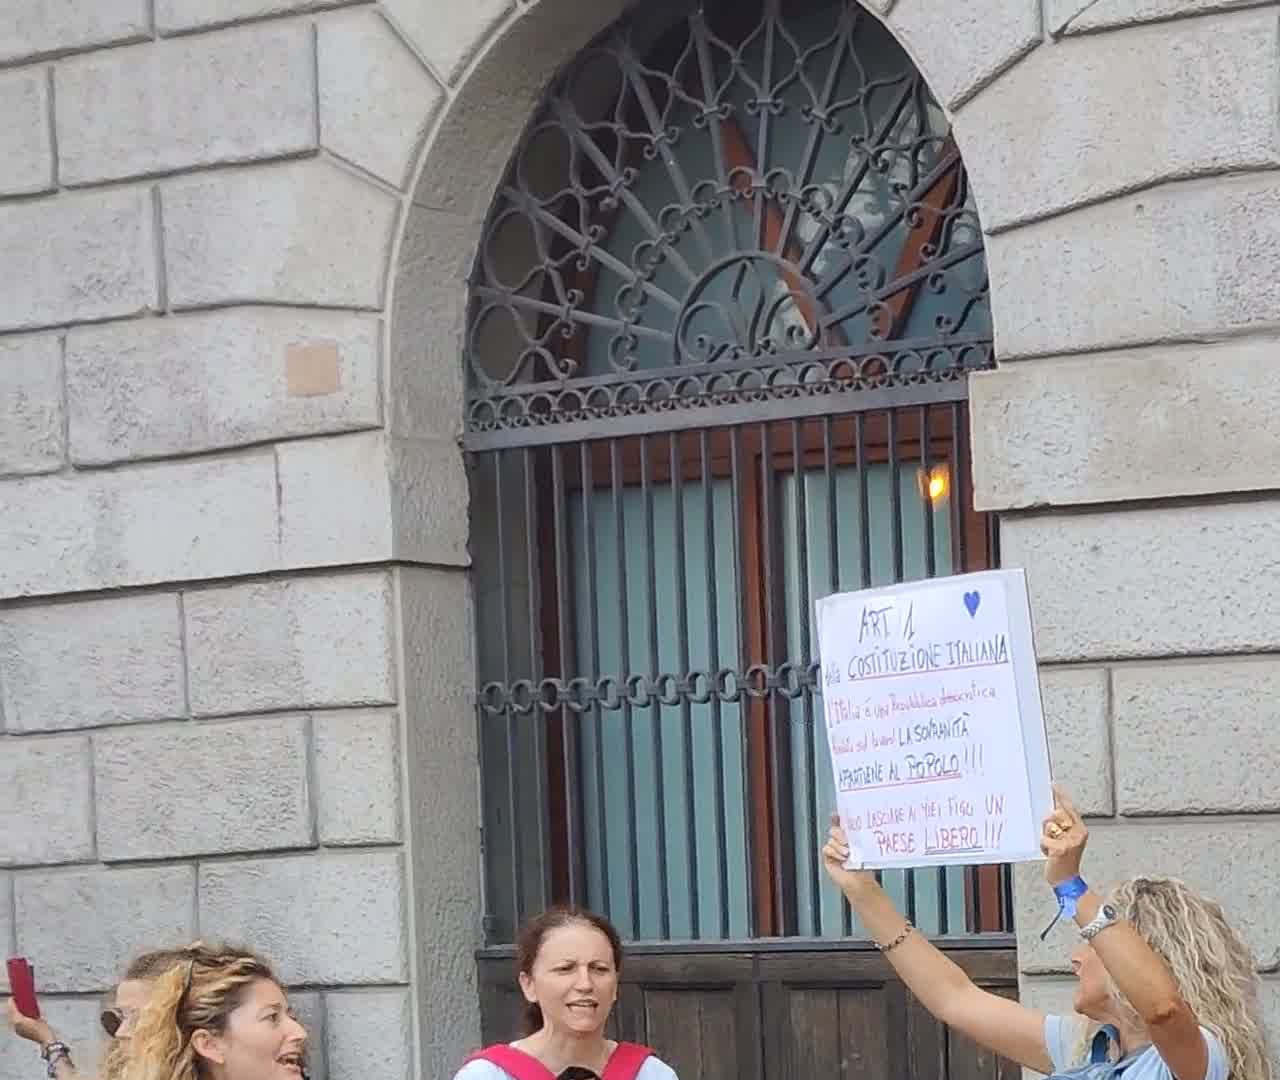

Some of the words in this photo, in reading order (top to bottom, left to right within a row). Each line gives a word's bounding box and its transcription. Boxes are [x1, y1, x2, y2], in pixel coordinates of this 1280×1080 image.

[859, 606, 893, 643] ART
[947, 634, 1009, 668] ITALIANA
[984, 792, 1005, 817] UN
[874, 831, 916, 857] PAESE
